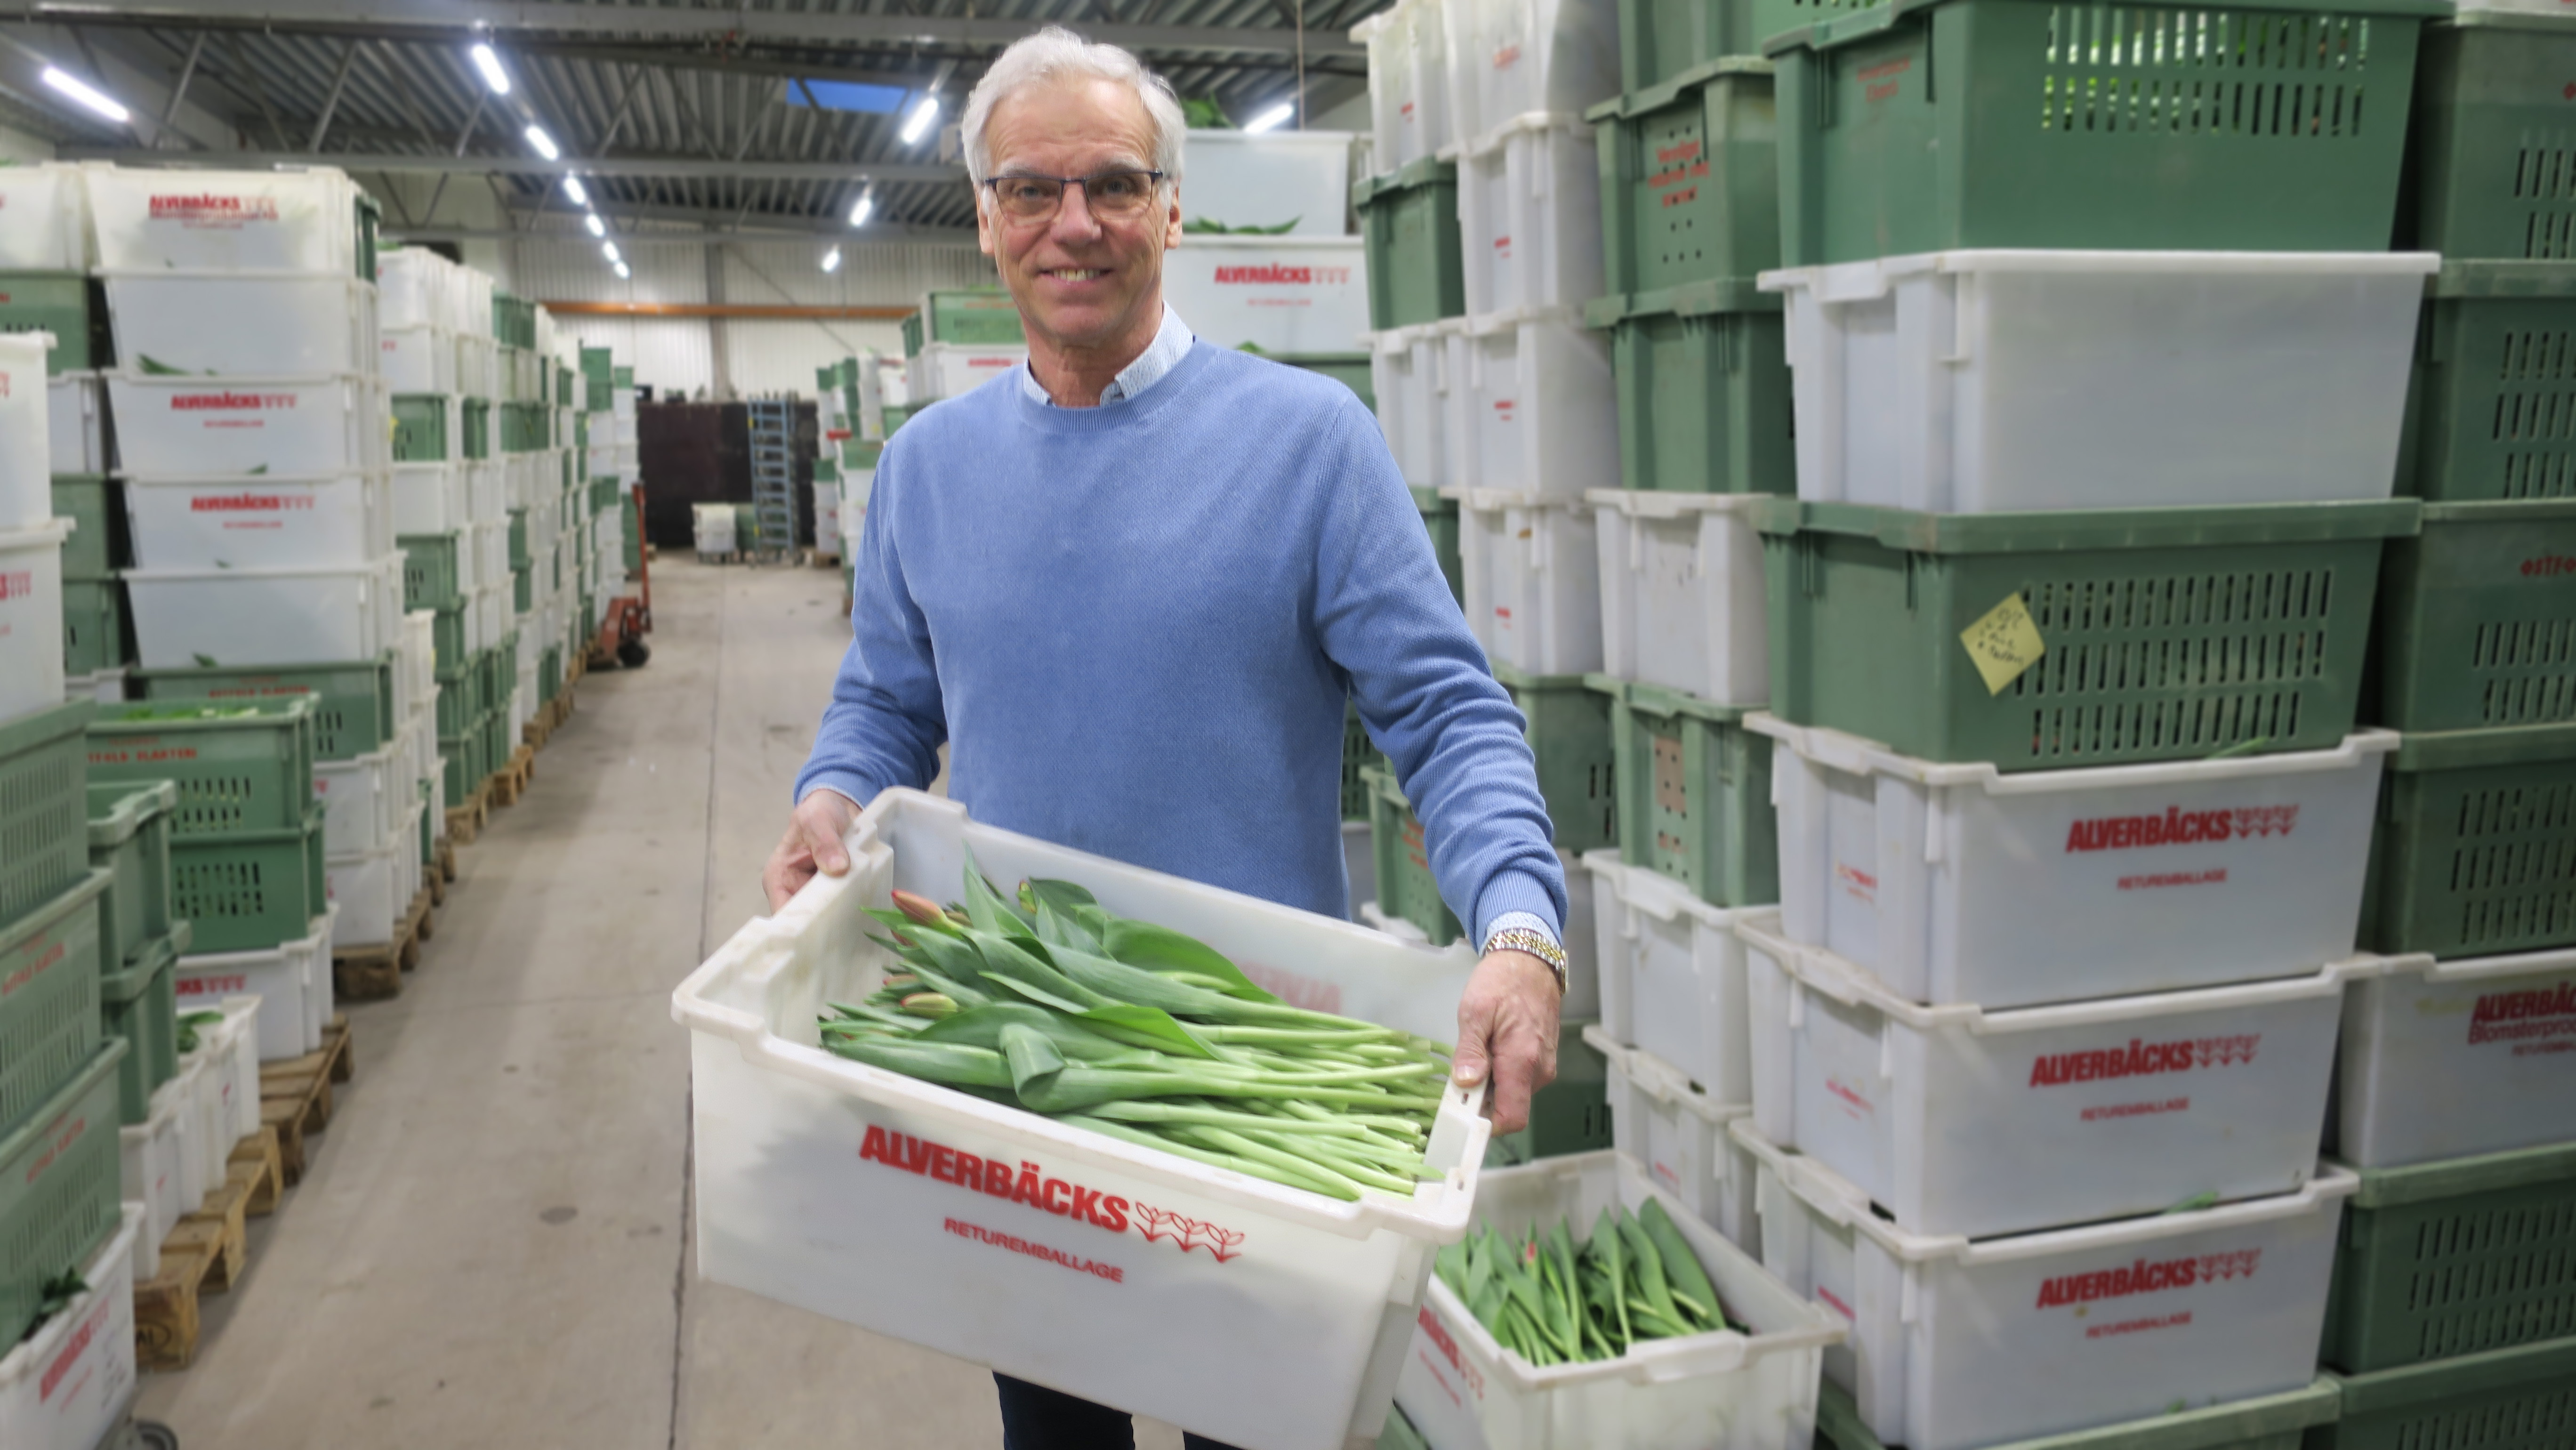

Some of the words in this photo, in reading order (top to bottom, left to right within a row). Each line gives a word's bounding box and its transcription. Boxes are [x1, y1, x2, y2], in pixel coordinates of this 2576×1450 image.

[1215, 263, 1312, 284] ALVERBÄCKS
[2066, 805, 2232, 853] ALVERBÄCKS
[2117, 868, 2227, 891] RETUREMBALLAGE
[2029, 1039, 2194, 1087] ALVERBÄCKS
[859, 1124, 1129, 1234] ALVERBÄCKS
[943, 1217, 1125, 1284] RETUREMBALLAGE
[2036, 1257, 2197, 1309] ALVERBÄCKS
